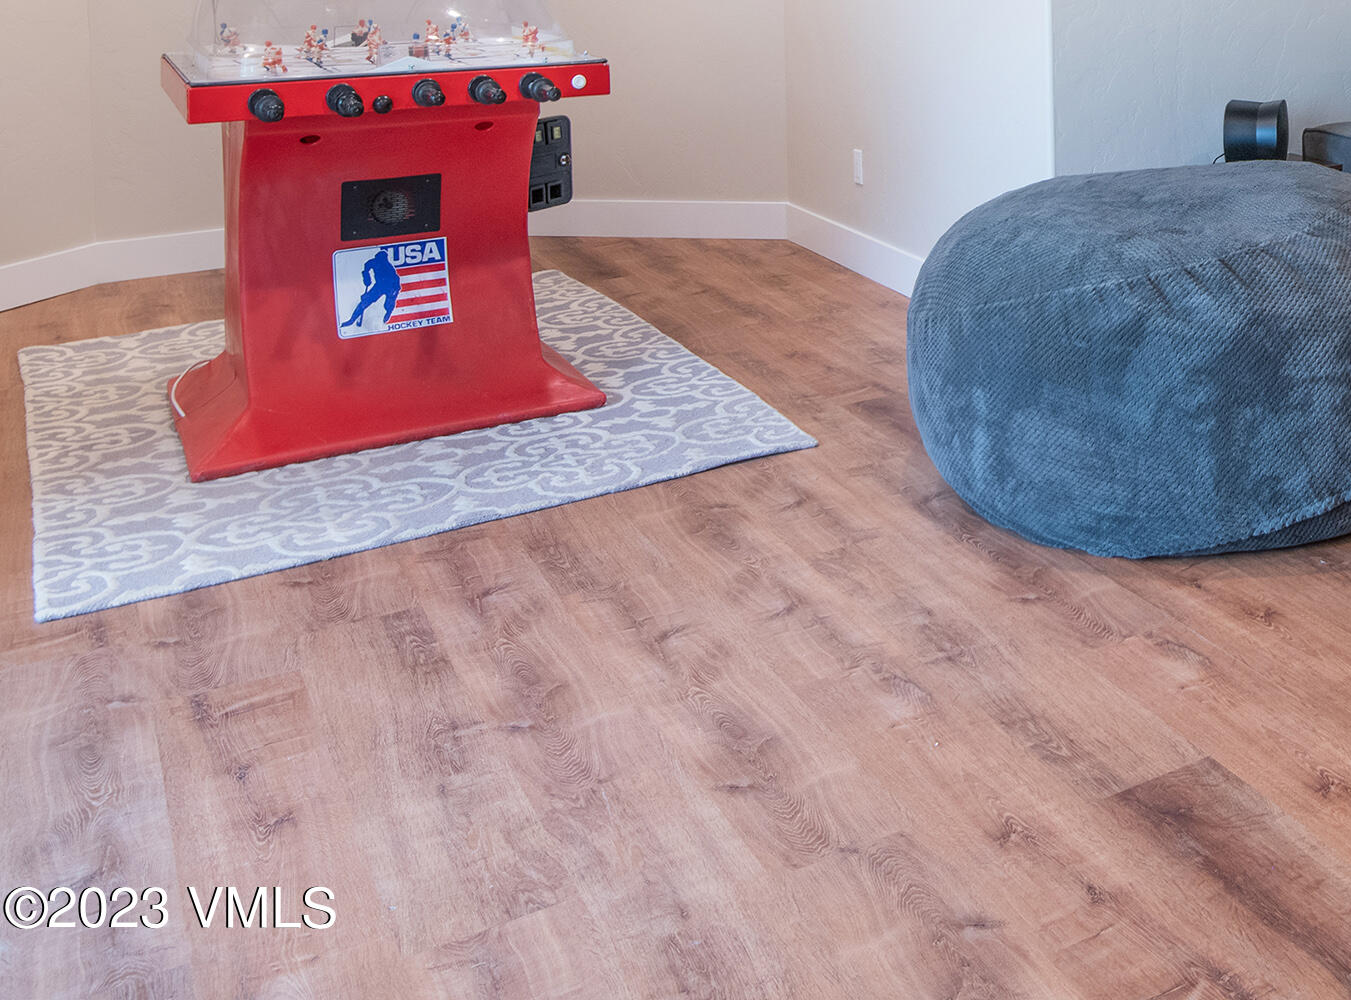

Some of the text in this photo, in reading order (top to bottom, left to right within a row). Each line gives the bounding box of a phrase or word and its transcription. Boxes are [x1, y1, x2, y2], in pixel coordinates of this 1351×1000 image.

[387, 241, 442, 267] USA
[387, 315, 451, 332] HOCKEY TEAM
